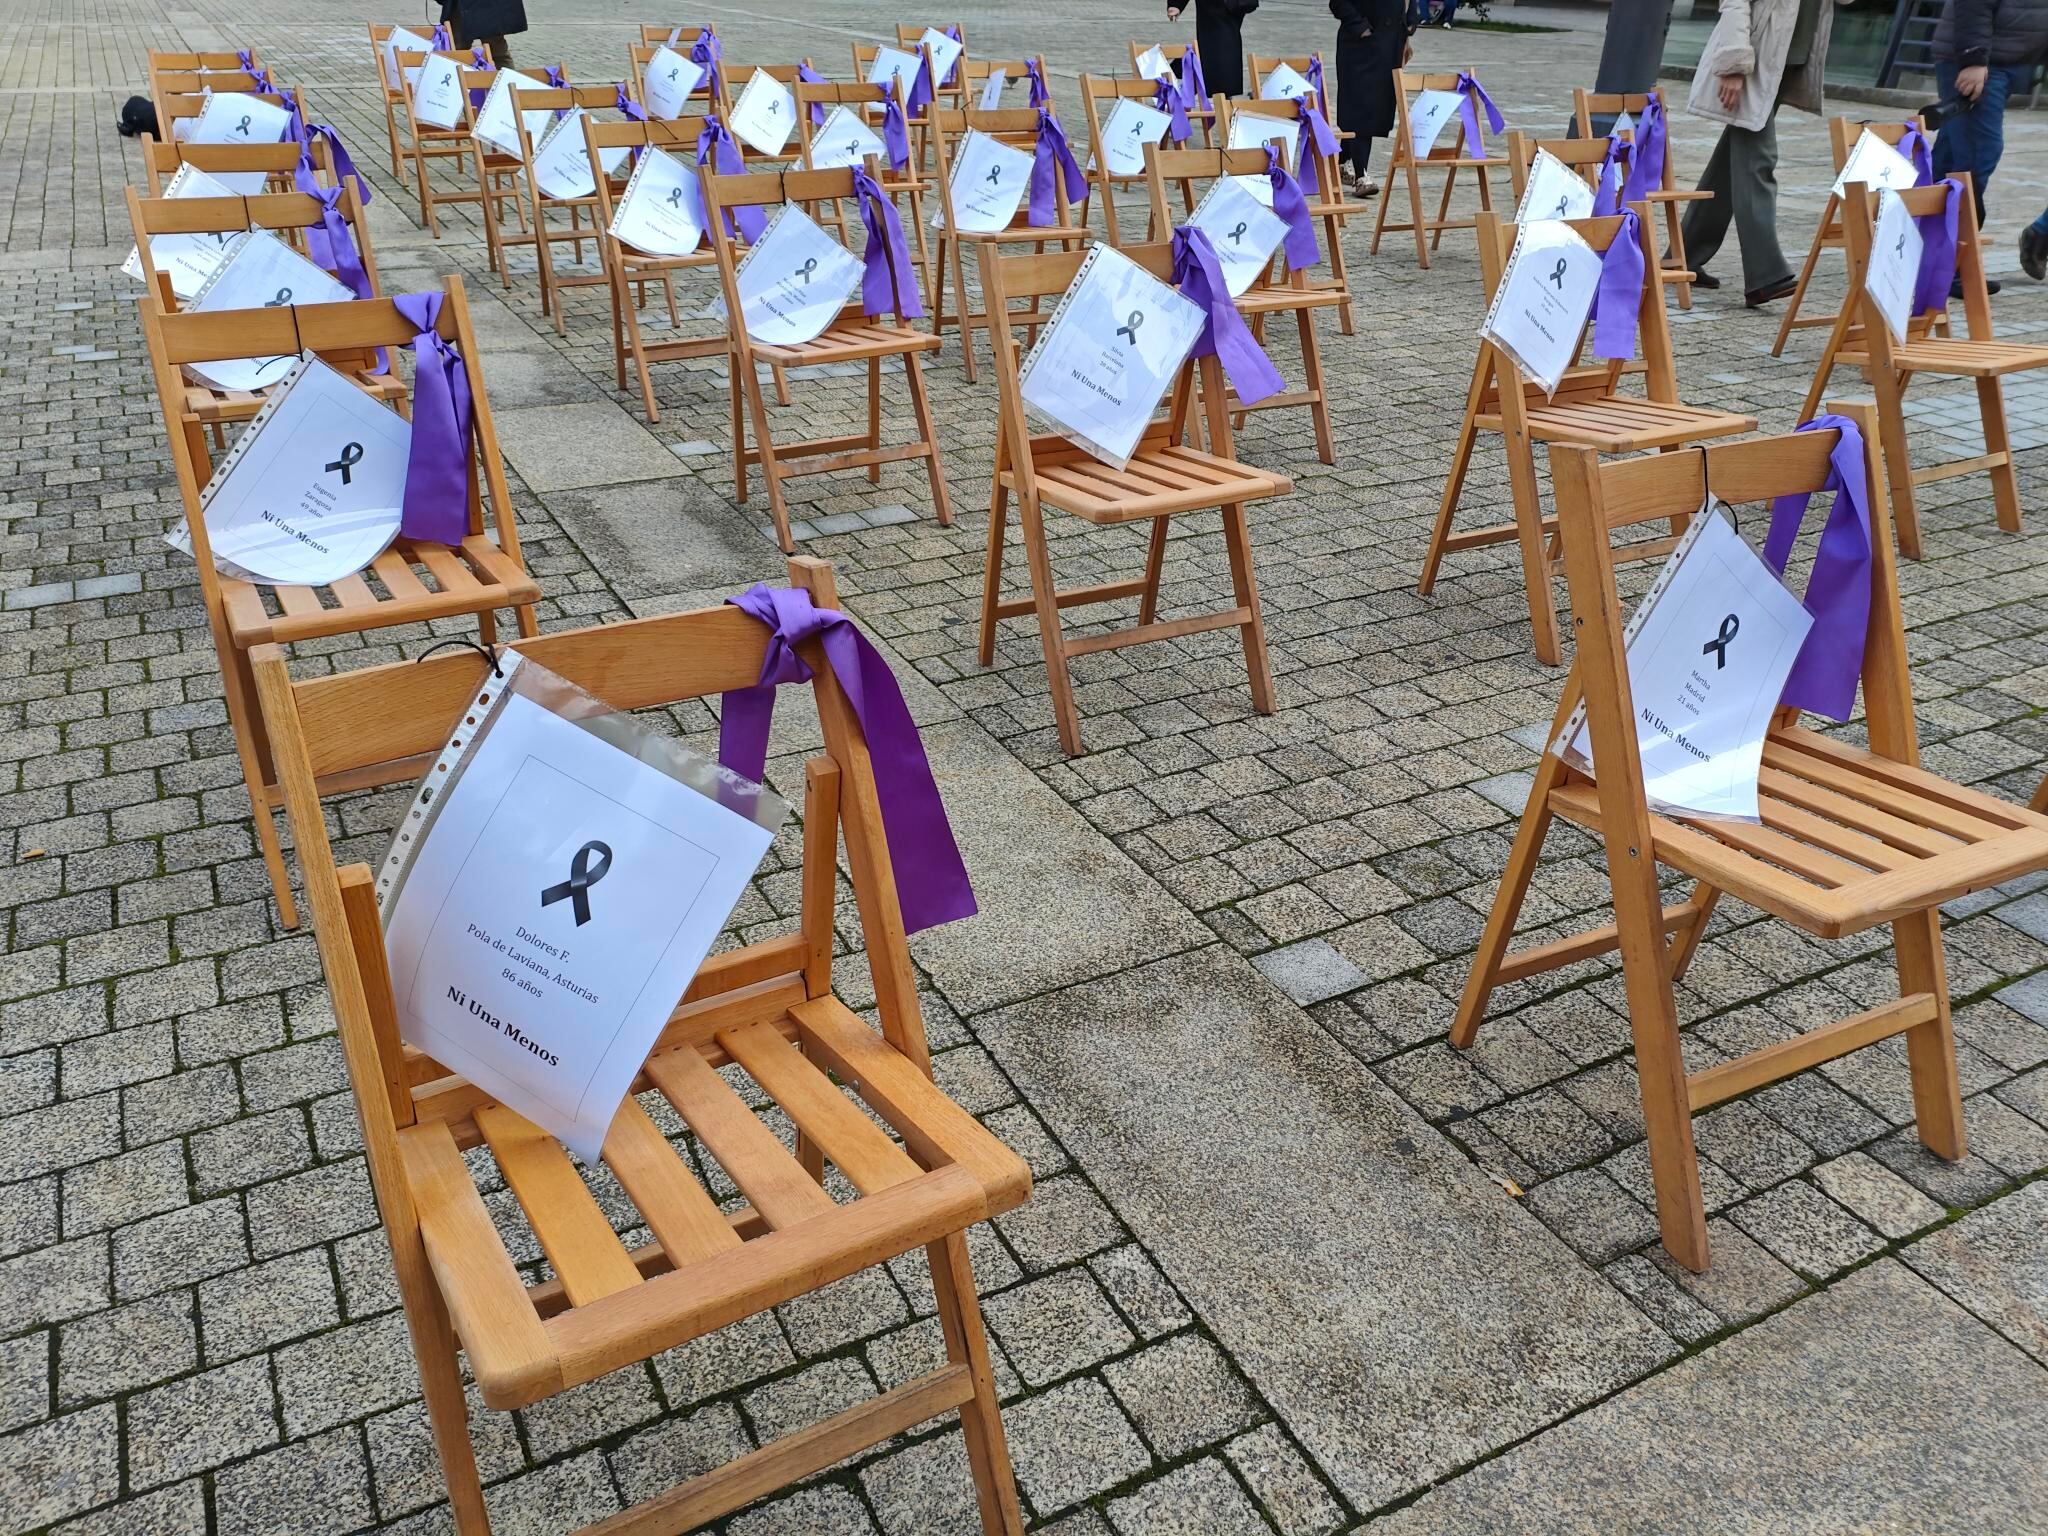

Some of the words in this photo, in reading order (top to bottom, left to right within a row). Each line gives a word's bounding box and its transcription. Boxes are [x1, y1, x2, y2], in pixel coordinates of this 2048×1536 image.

[759, 296, 765, 304] Ni
[766, 302, 777, 313] Una
[777, 311, 796, 327] Menos
[1531, 314, 1540, 328] Una
[1540, 325, 1555, 343] Menos
[1071, 369, 1081, 380] Ni
[1081, 375, 1096, 389] Una
[1097, 386, 1122, 406] Menos
[305, 491, 331, 511] Zaragoza
[313, 482, 336, 501] Eugenia
[309, 507, 323, 518] años
[261, 510, 274, 522] Ni
[275, 519, 294, 535] Una
[296, 531, 329, 553] Menos
[1684, 682, 1705, 702] Madrid
[1691, 670, 1711, 690] Martha
[1677, 695, 1686, 704] 21
[1686, 703, 1700, 715] años
[1641, 708, 1654, 723] Ni
[1654, 718, 1674, 739] Una
[1675, 734, 1711, 762] Menos
[515, 926, 559, 957] Dolores
[560, 951, 569, 963] F.
[467, 923, 490, 944] Pola
[492, 940, 507, 952] de
[507, 947, 551, 979] Laviana,
[552, 973, 599, 1004] Asturias
[502, 968, 516, 982] 86
[517, 980, 543, 998] años
[447, 986, 466, 1006] Ni
[469, 1000, 500, 1030] Una
[504, 1023, 560, 1067] Menos
